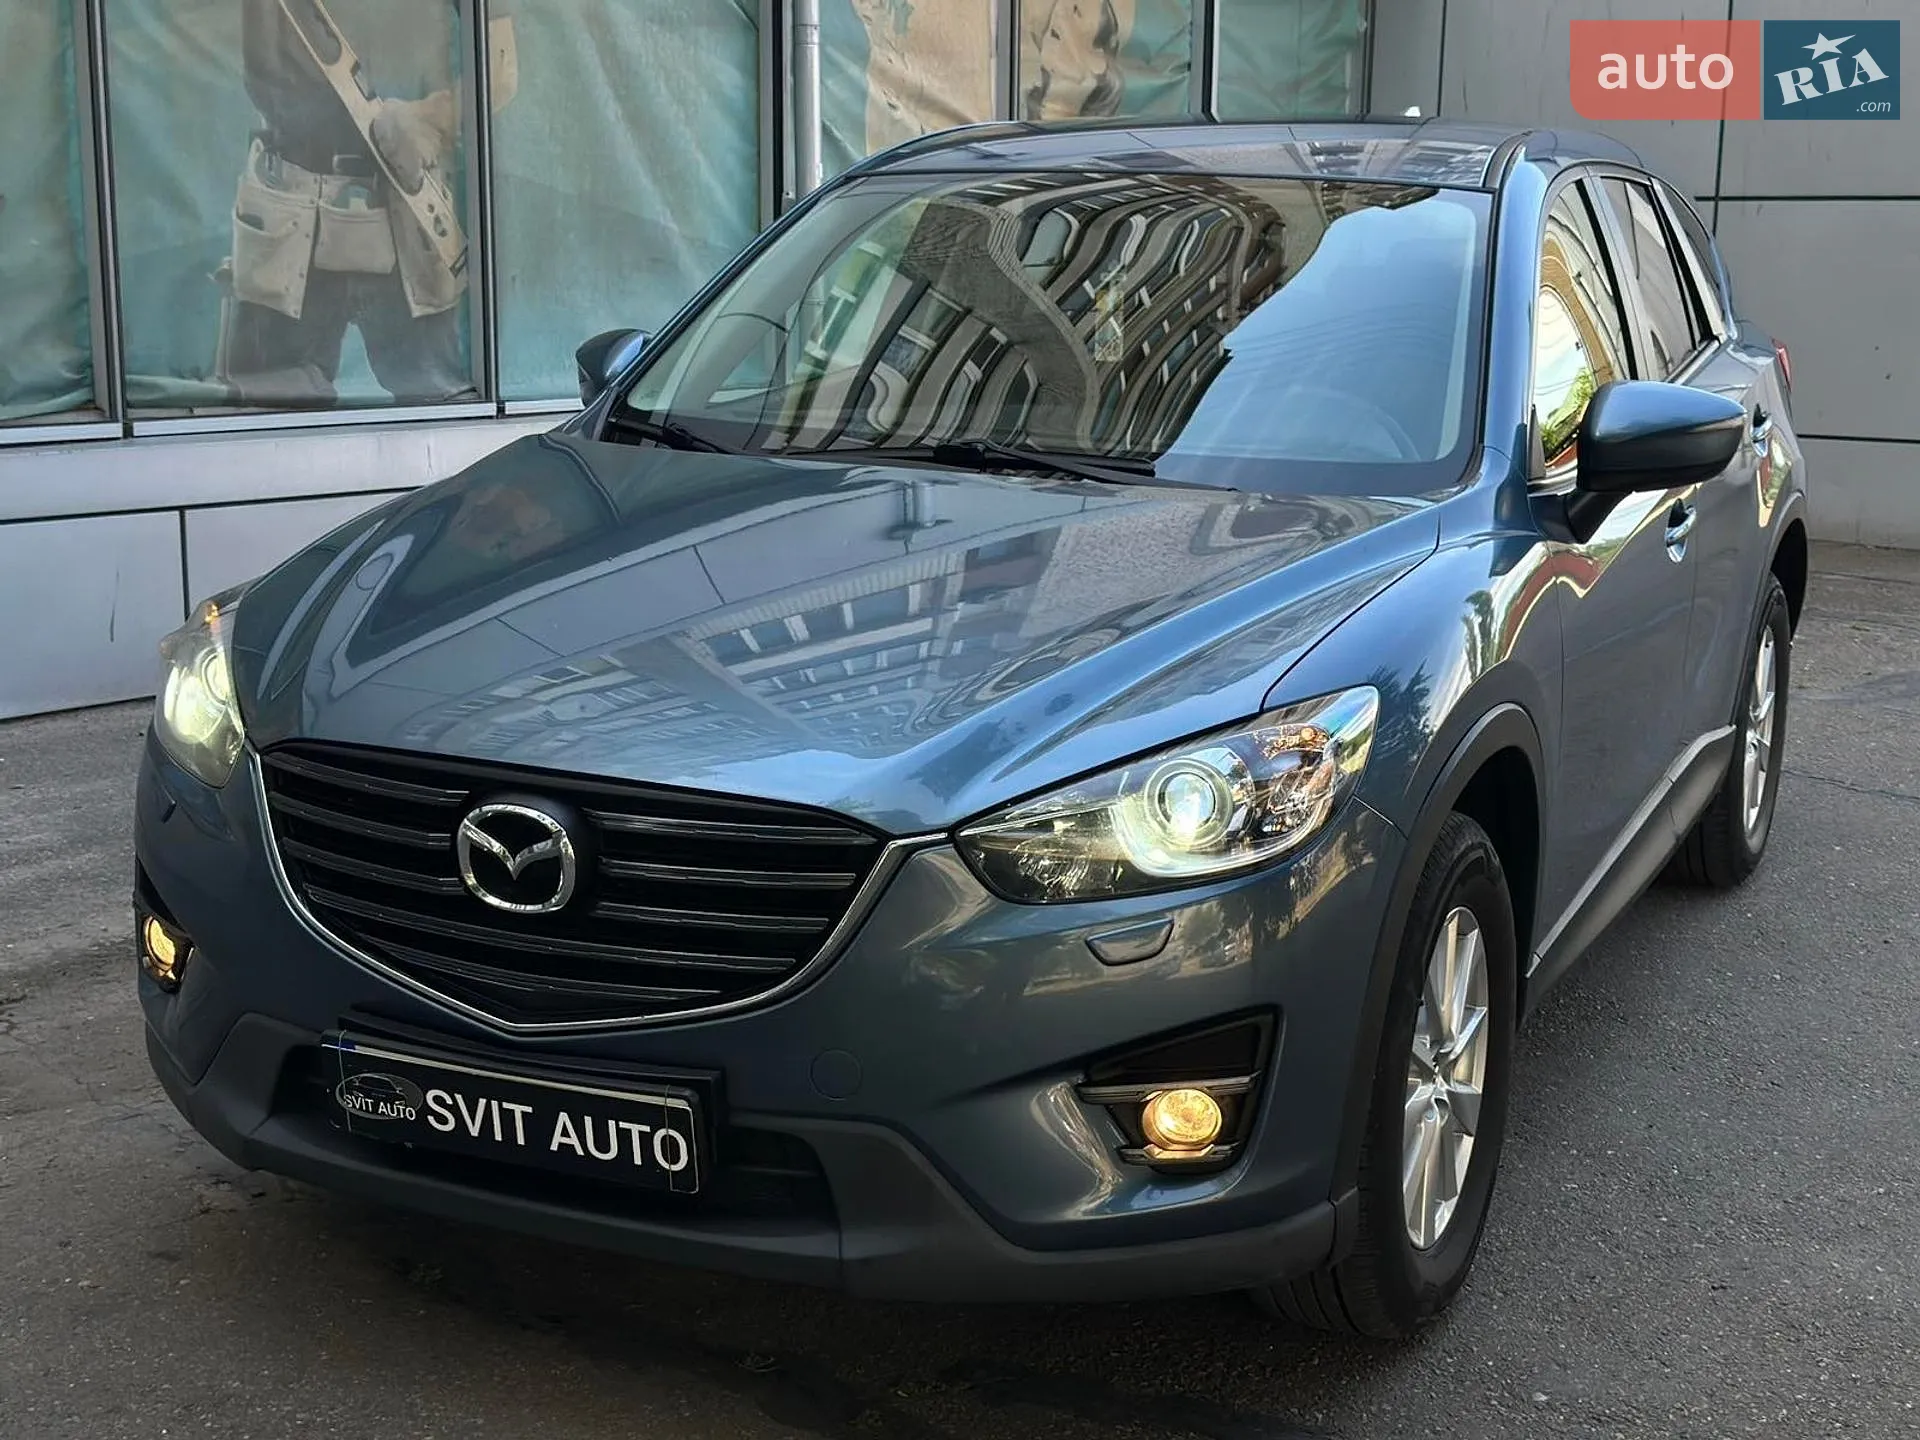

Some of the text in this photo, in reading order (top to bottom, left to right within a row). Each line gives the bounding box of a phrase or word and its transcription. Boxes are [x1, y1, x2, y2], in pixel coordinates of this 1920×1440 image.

[344, 1094, 416, 1121] SVIT AUTO
[426, 1089, 689, 1172] SVIT AUTO
